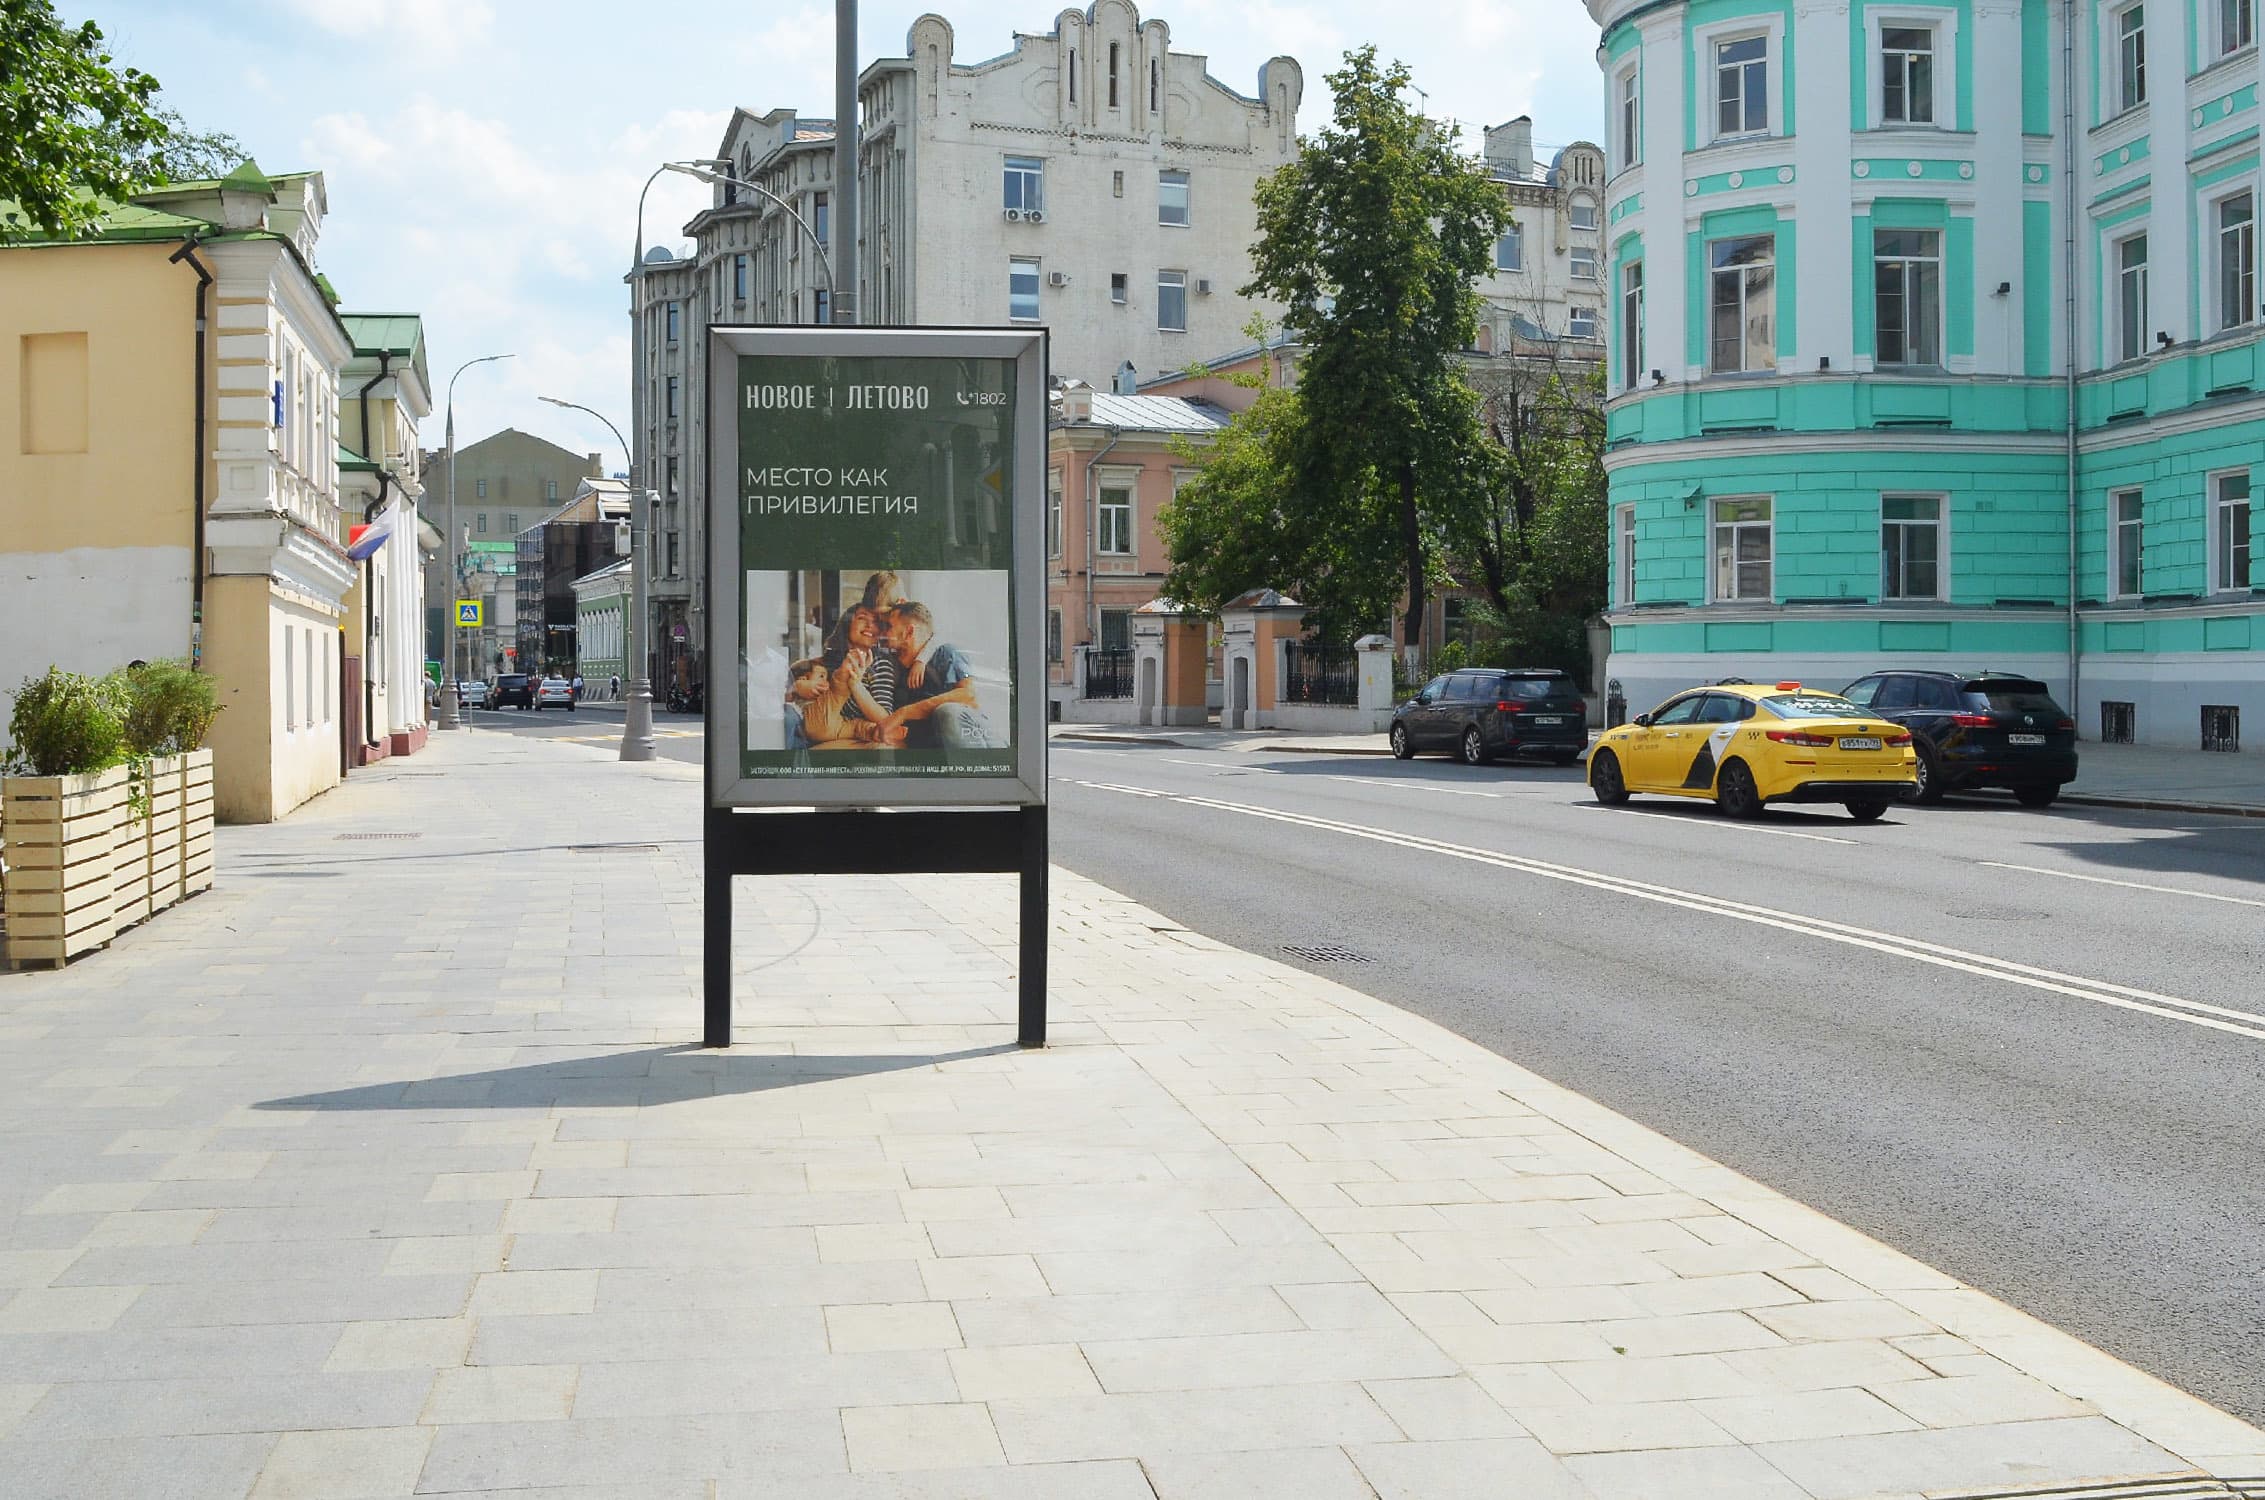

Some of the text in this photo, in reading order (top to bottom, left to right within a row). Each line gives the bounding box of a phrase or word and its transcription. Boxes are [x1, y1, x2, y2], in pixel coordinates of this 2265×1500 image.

[746, 384, 929, 409] НОВОЕ ЛЕТОВО
[747, 467, 888, 487] МЕСТО КАК
[747, 495, 918, 515] ПРИВИЛЕГИЯ
